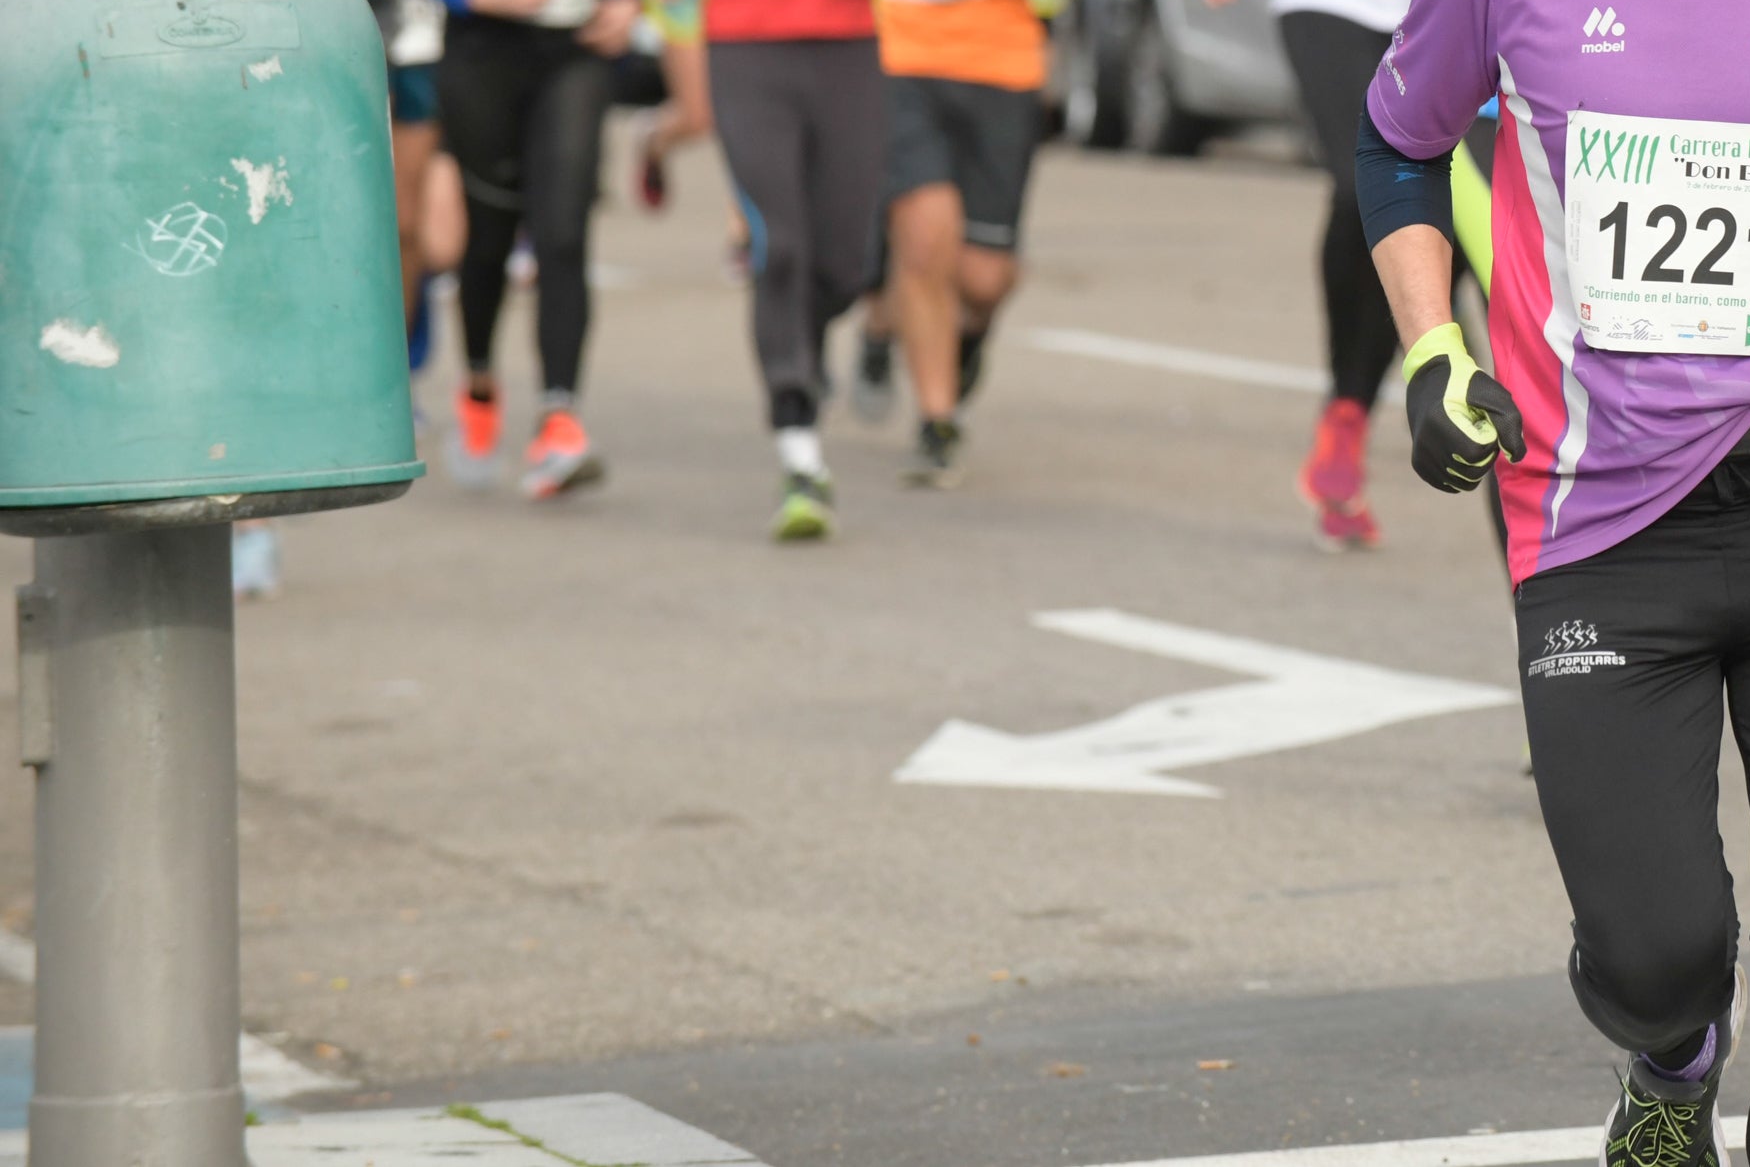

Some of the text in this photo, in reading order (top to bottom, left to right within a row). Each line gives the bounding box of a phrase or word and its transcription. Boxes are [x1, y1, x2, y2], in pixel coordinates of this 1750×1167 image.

[1581, 40, 1625, 53] mobel
[1573, 127, 1660, 185] XXIII
[1670, 134, 1742, 159] Carrera
[1644, 293, 1657, 303] en
[1661, 291, 1672, 303] el
[1675, 293, 1712, 307] barrio,
[1717, 298, 1747, 308] como
[1528, 655, 1626, 677] ATLETAS POPULARES
[1545, 665, 1592, 678] VALLADOLID
